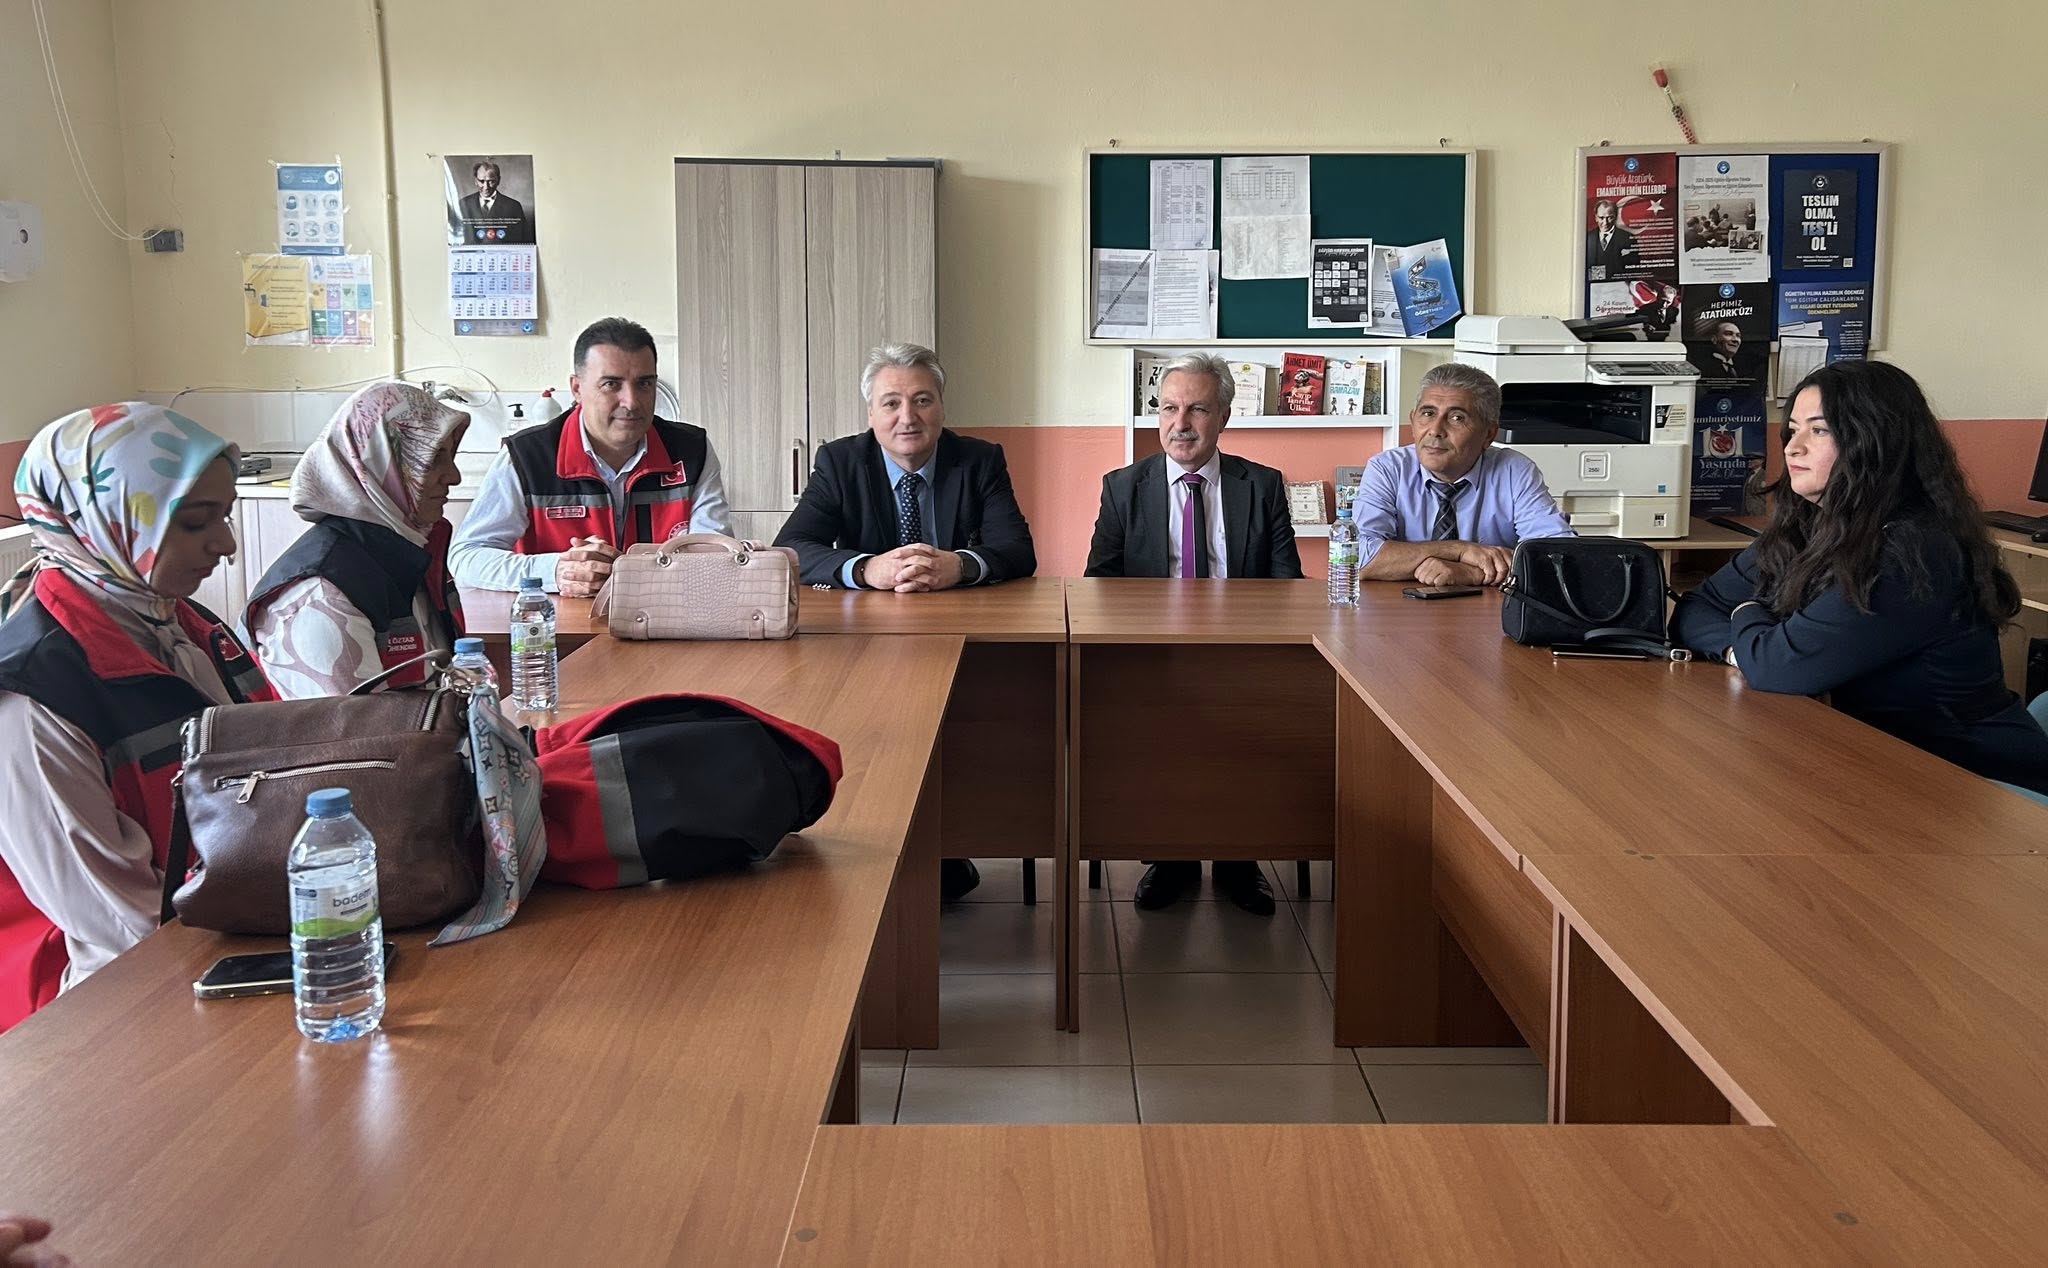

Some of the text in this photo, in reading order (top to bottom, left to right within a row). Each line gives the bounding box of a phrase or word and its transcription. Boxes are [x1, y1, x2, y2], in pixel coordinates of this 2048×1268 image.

[1804, 207, 1836, 220] OLMA,
[1811, 236, 1827, 251] OL
[1710, 299, 1742, 309] HEPİMİZ
